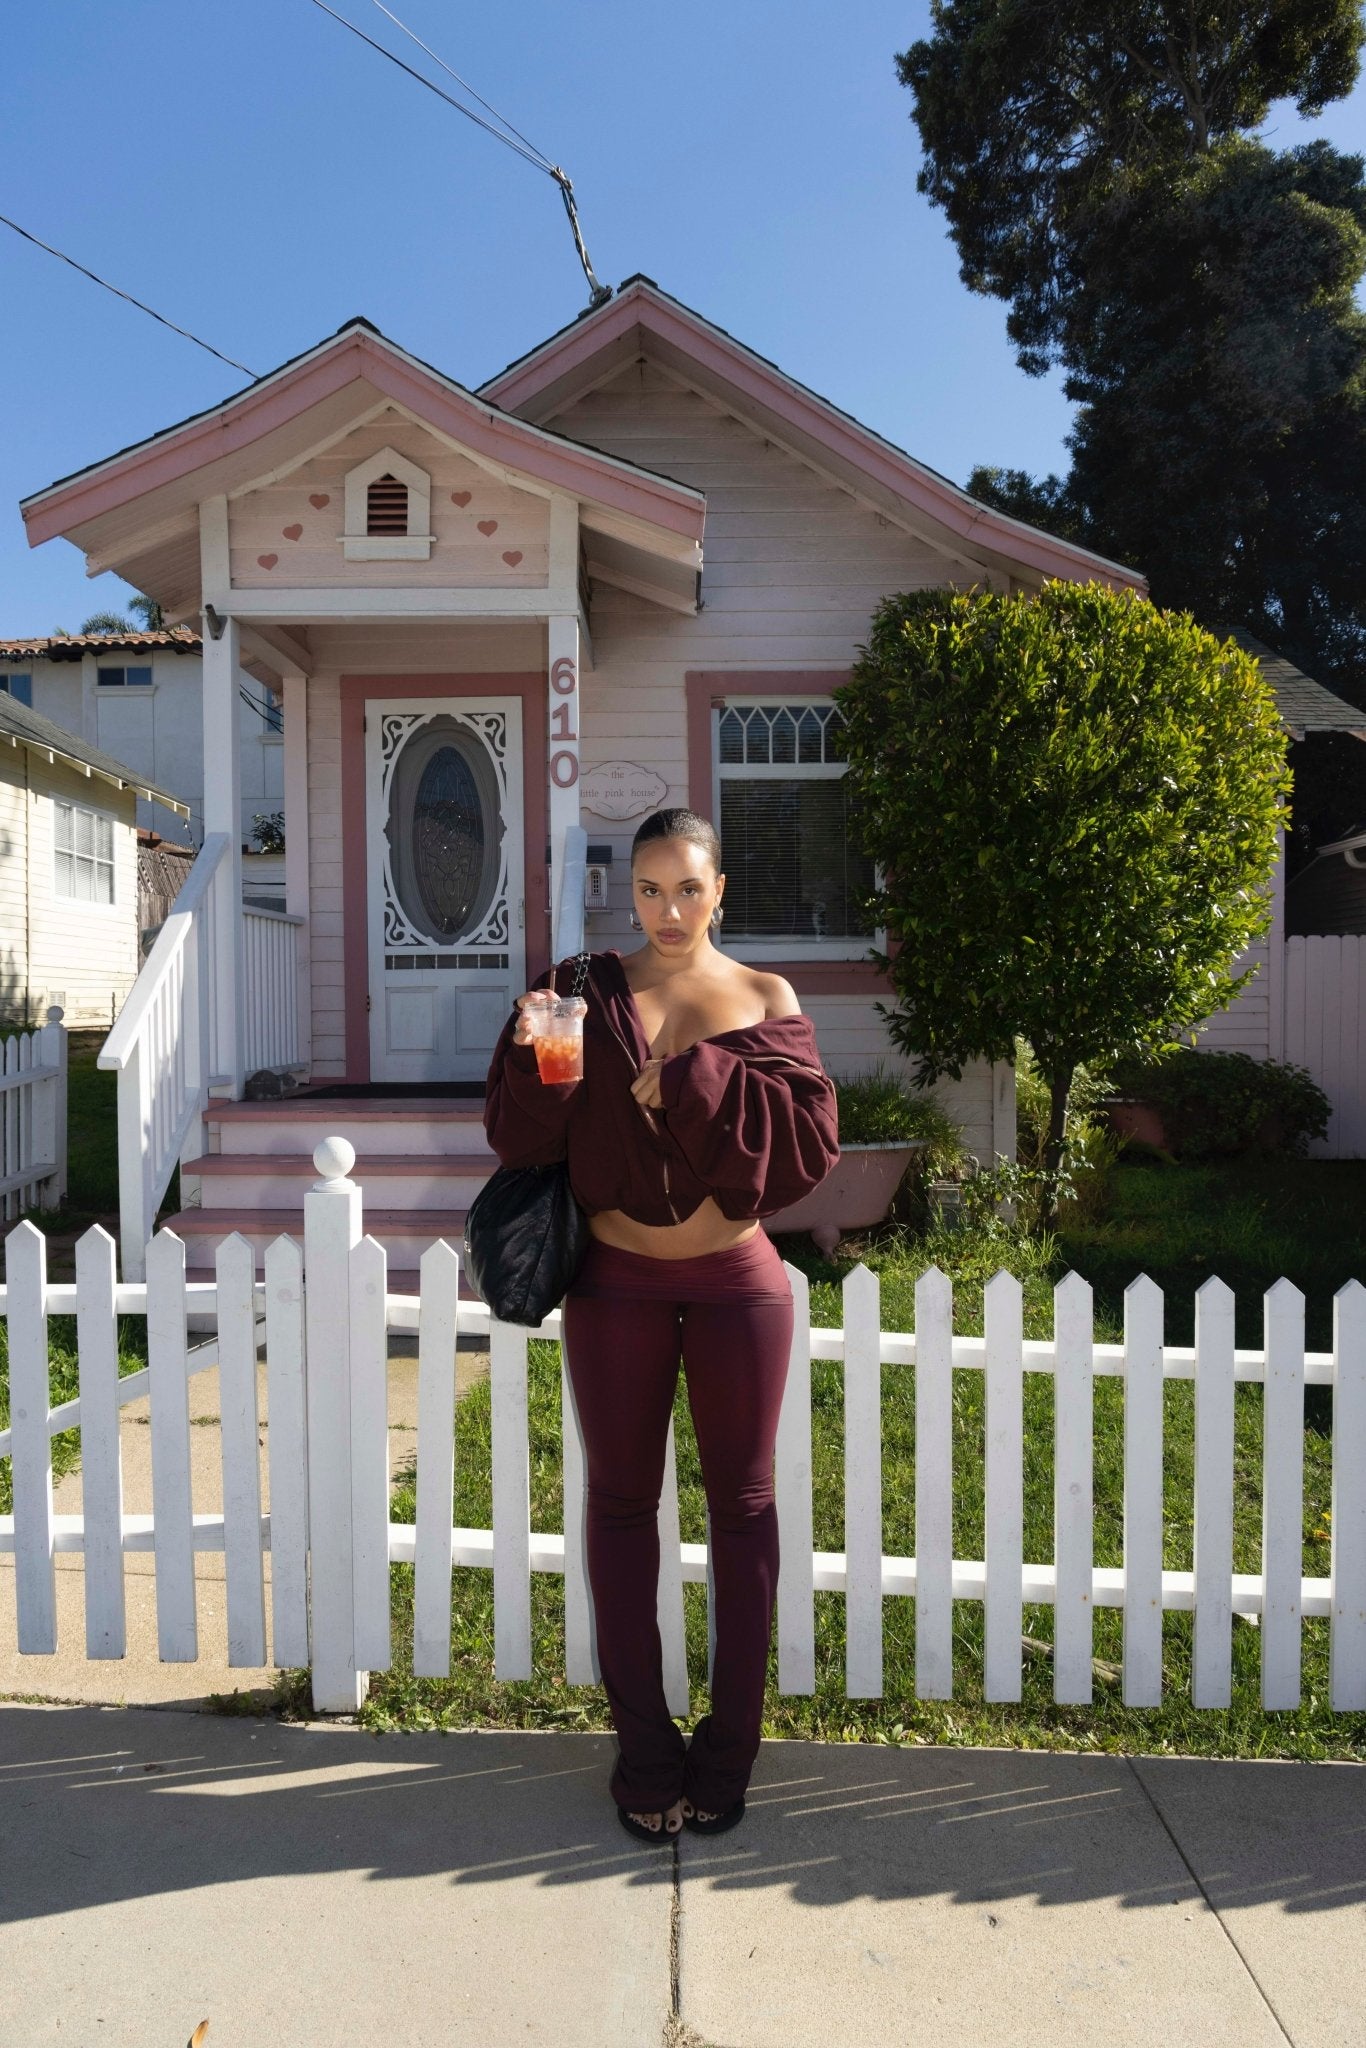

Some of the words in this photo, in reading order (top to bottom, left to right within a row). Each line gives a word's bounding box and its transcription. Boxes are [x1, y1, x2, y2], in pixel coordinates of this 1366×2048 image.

[550, 657, 579, 789] 610
[611, 770, 625, 779] the
[605, 788, 625, 799] pink
[631, 788, 656, 797] house
